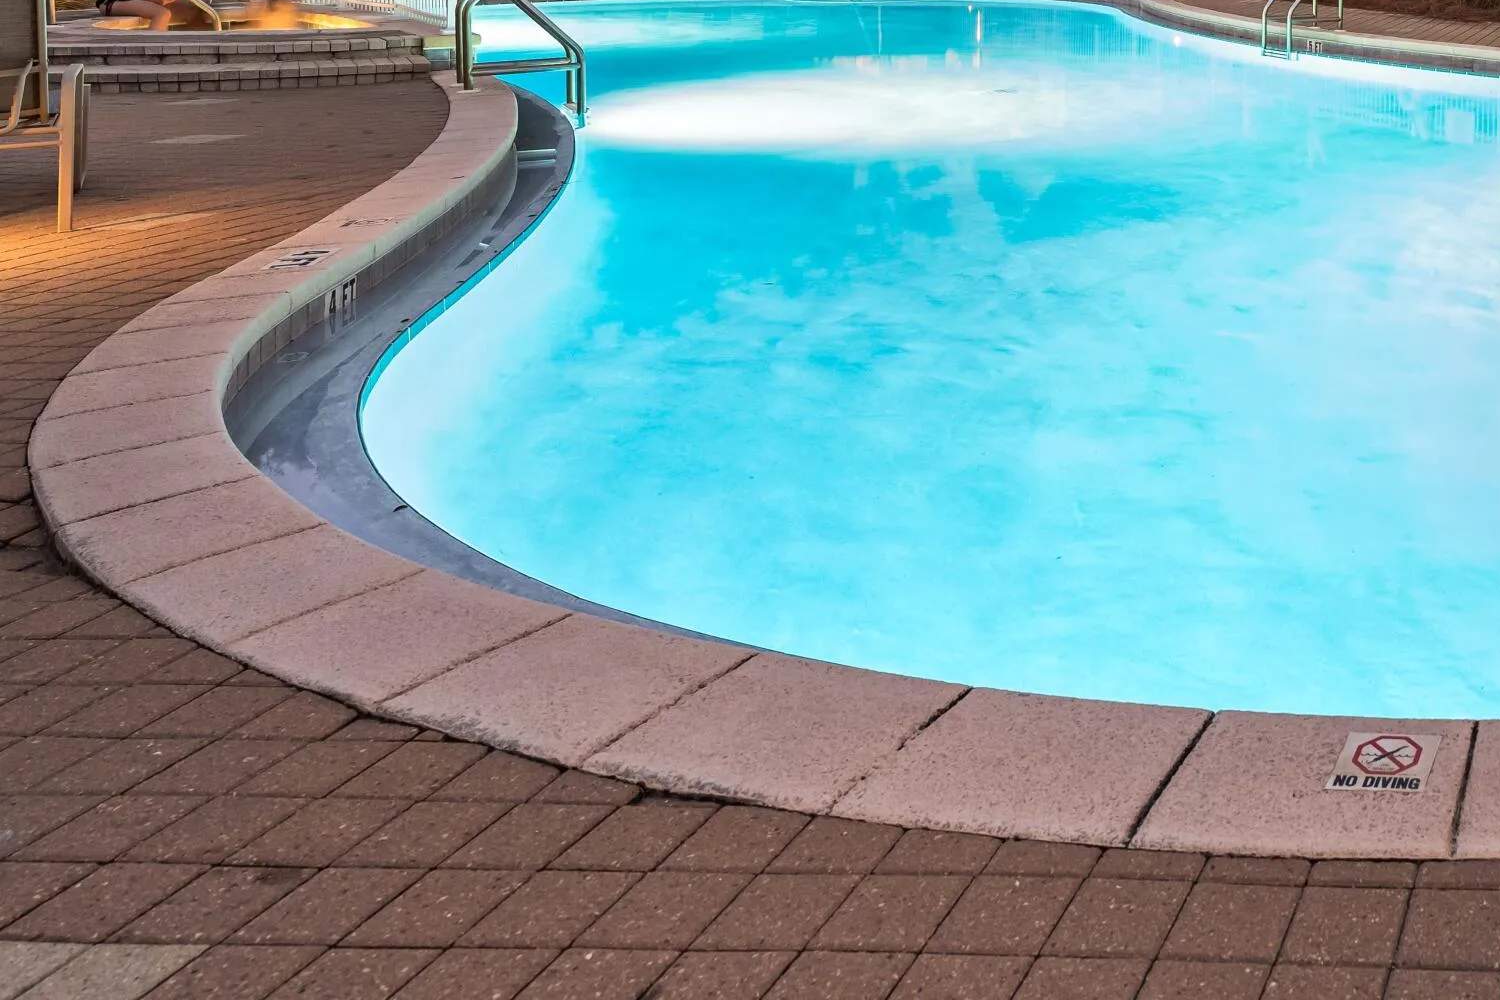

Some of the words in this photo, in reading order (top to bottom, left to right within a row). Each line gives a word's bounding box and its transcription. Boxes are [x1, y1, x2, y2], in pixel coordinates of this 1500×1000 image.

[1315, 41, 1322, 53] FT
[329, 289, 337, 314] 4
[342, 277, 356, 308] FT
[1332, 774, 1358, 787] NO
[1362, 775, 1421, 790] DIVING
